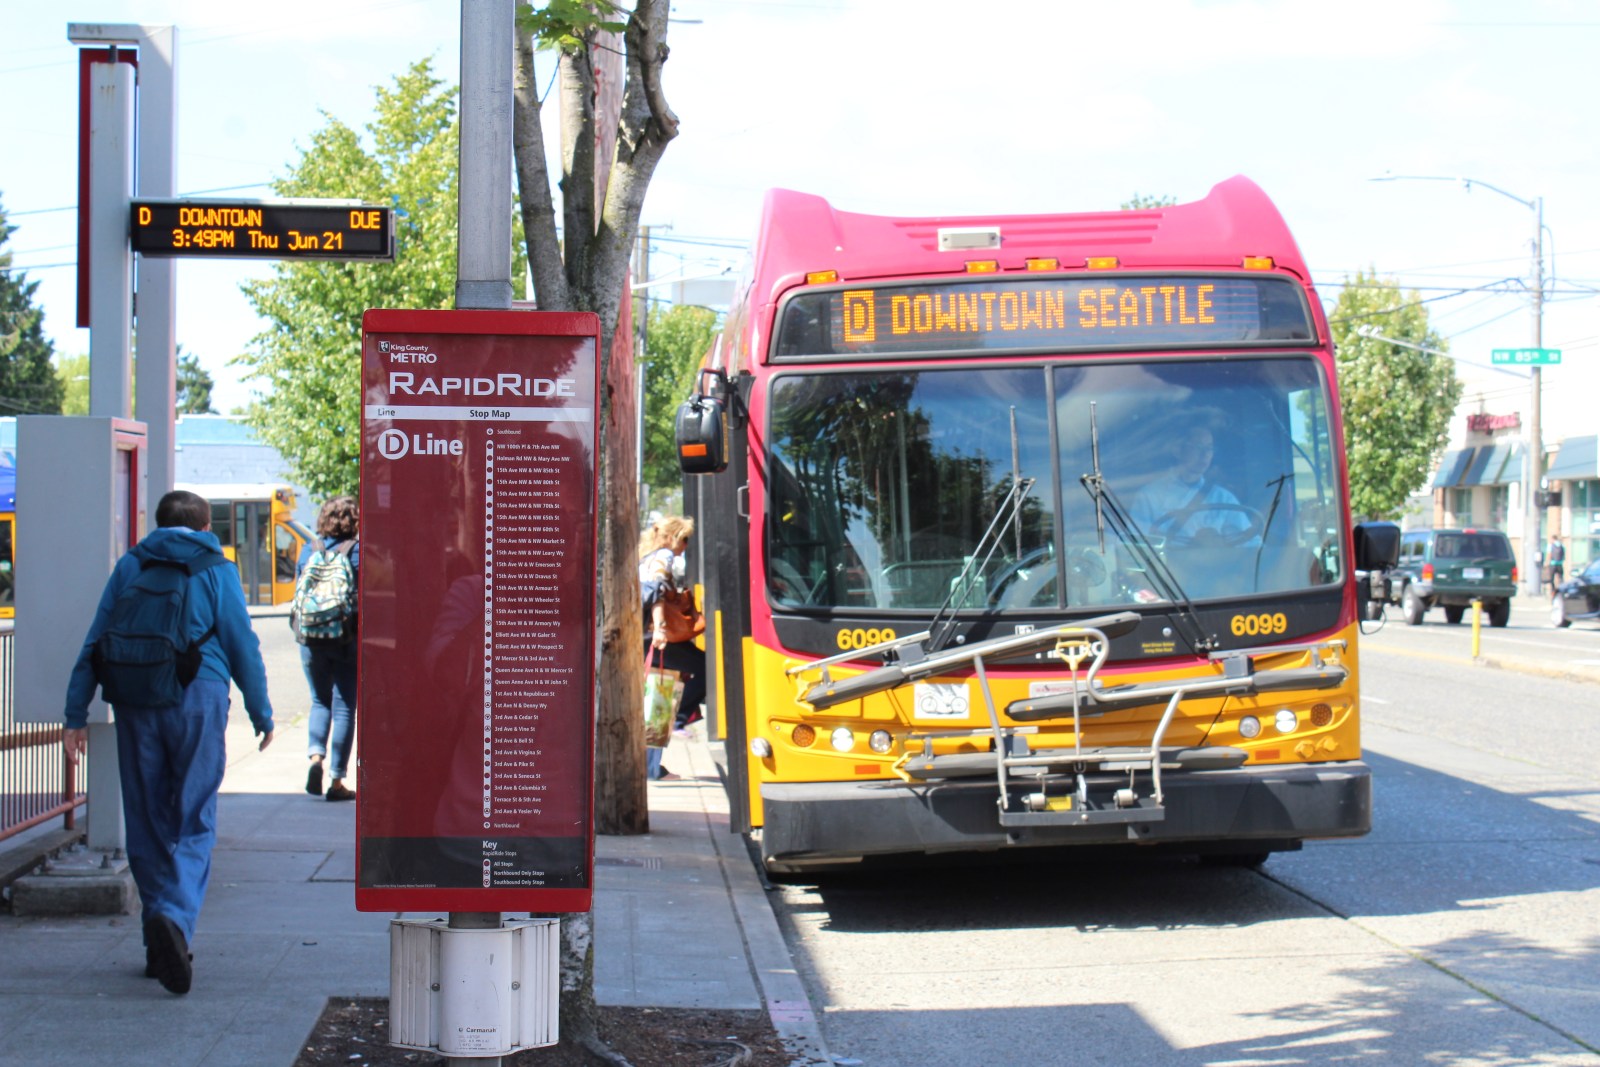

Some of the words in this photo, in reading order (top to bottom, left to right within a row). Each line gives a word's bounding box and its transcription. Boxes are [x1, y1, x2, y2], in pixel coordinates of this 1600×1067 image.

[139, 206, 151, 225] D
[180, 208, 262, 226] DOWNTOWN
[350, 211, 380, 228] DUE
[172, 229, 234, 248] 3:49PM
[248, 230, 278, 248] Thu
[288, 231, 318, 250] Jun
[322, 232, 342, 250] 21
[891, 291, 1065, 334] DOWNTOWN
[1079, 284, 1214, 328] SEATTLE
[390, 352, 438, 364] METRO
[470, 410, 489, 418] Stop
[492, 410, 510, 418] Map
[413, 432, 464, 456] Line
[1231, 613, 1287, 636] 6099
[482, 841, 497, 850] Key
